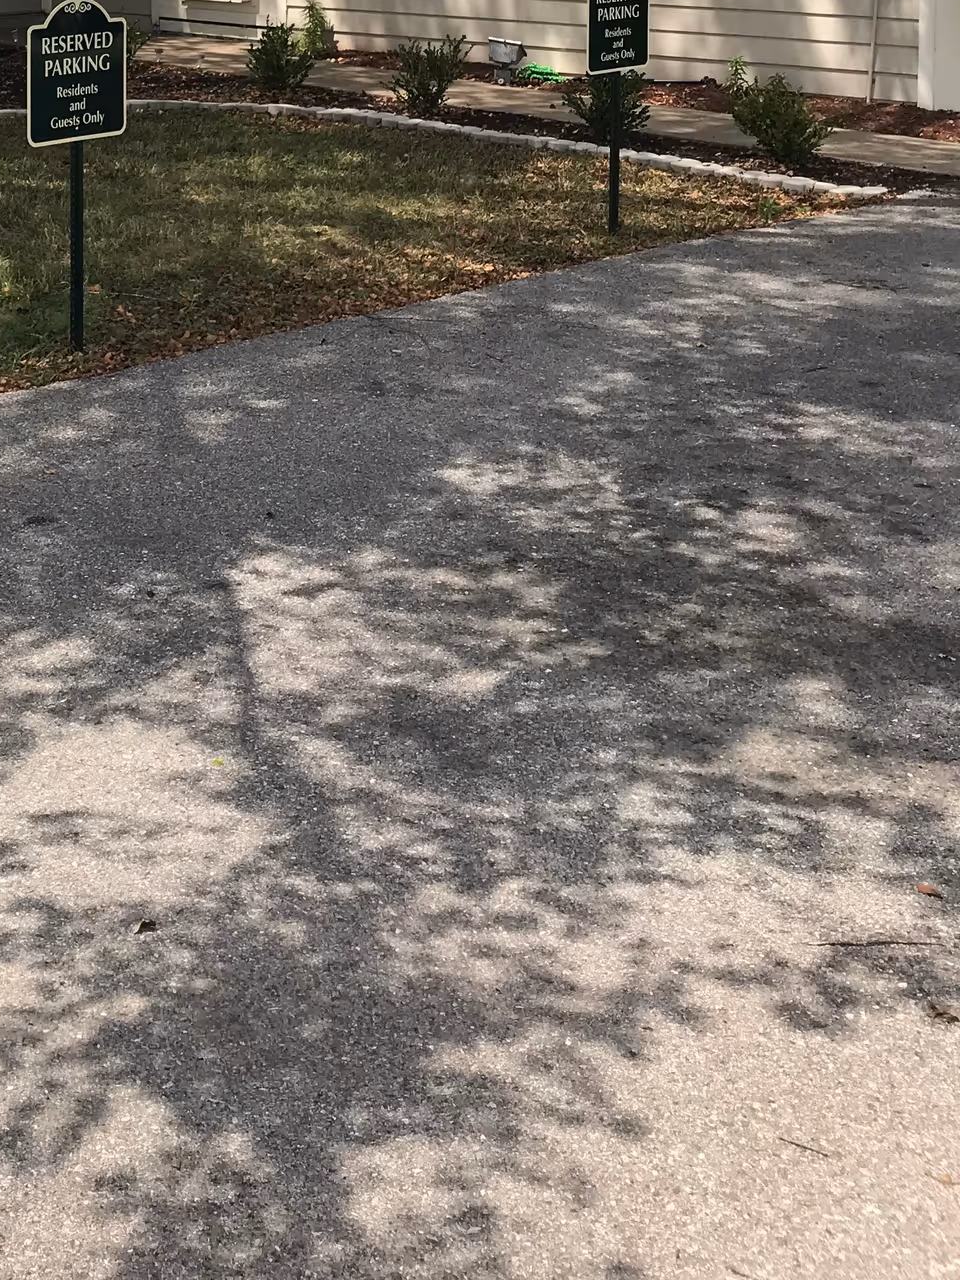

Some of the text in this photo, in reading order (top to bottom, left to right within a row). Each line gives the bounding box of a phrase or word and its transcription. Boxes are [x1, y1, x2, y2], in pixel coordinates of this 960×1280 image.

[598, 4, 639, 21] PARKING
[605, 27, 632, 38] Residents
[41, 31, 114, 55] RESERVED
[613, 38, 623, 48] and
[601, 48, 635, 61] Guests Only
[44, 54, 110, 78] PARKING
[57, 83, 99, 98] Residents
[69, 97, 86, 112] and
[50, 110, 105, 129] Guests Only
